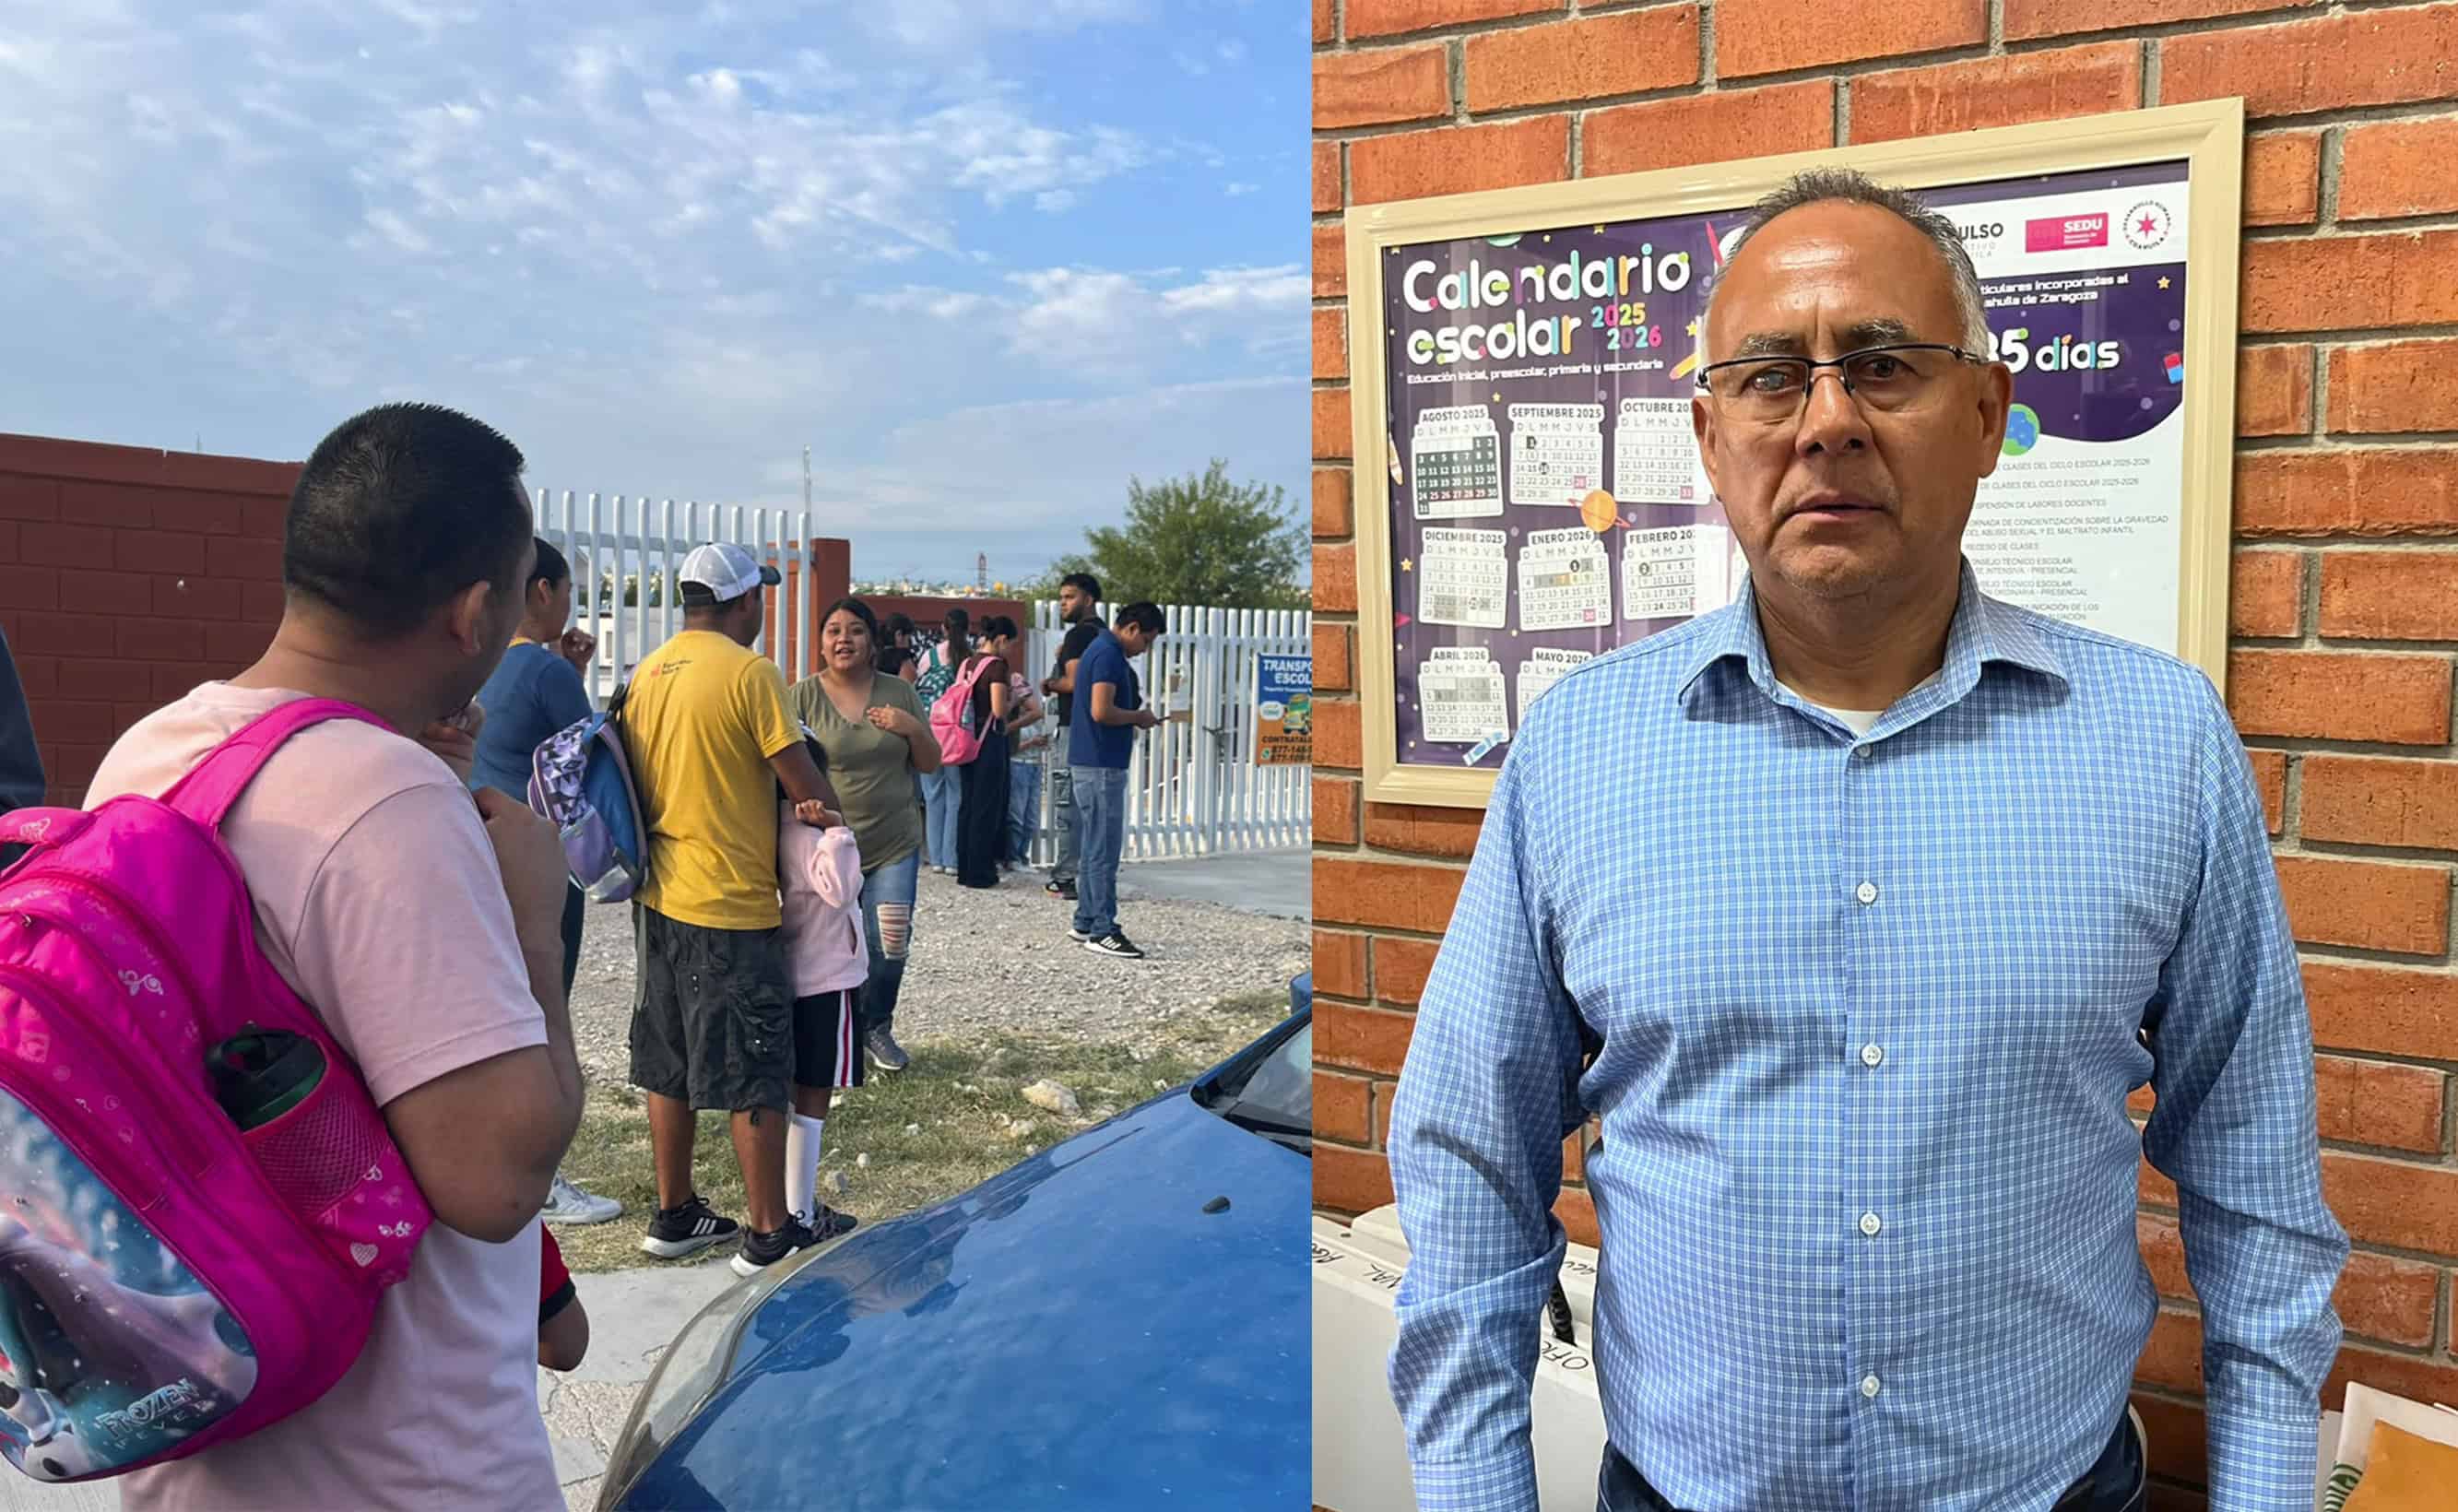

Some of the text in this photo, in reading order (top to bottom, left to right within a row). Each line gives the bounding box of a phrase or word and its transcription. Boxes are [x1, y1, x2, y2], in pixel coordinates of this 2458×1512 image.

[2063, 218, 2103, 234] SEDU
[1403, 242, 1691, 313] Calendario
[2022, 294, 2037, 305] de
[2039, 290, 2098, 305] Zaragoza
[1591, 301, 1647, 329] 2025
[1407, 309, 1582, 365] escolar
[1607, 325, 1662, 350] 2026
[2035, 333, 2120, 372] días
[1407, 370, 1457, 384] Educación
[1549, 363, 1592, 377] primaria
[1593, 364, 1601, 375] y
[1602, 359, 1664, 373] secundaria
[1422, 408, 1485, 422] AGOSTO 2025
[1511, 408, 1601, 419] SEPTIEMBRE 2025
[1624, 402, 1674, 413] OCTUBRE
[1424, 531, 1504, 544] DICIEMBRE 2025
[1531, 530, 1592, 545] ENERO 2026
[1629, 530, 1678, 544] FEBRERO
[1434, 650, 1486, 660] ABRIL 2026
[1536, 651, 1564, 663] MAYO
[93, 1377, 200, 1439] FROZEN
